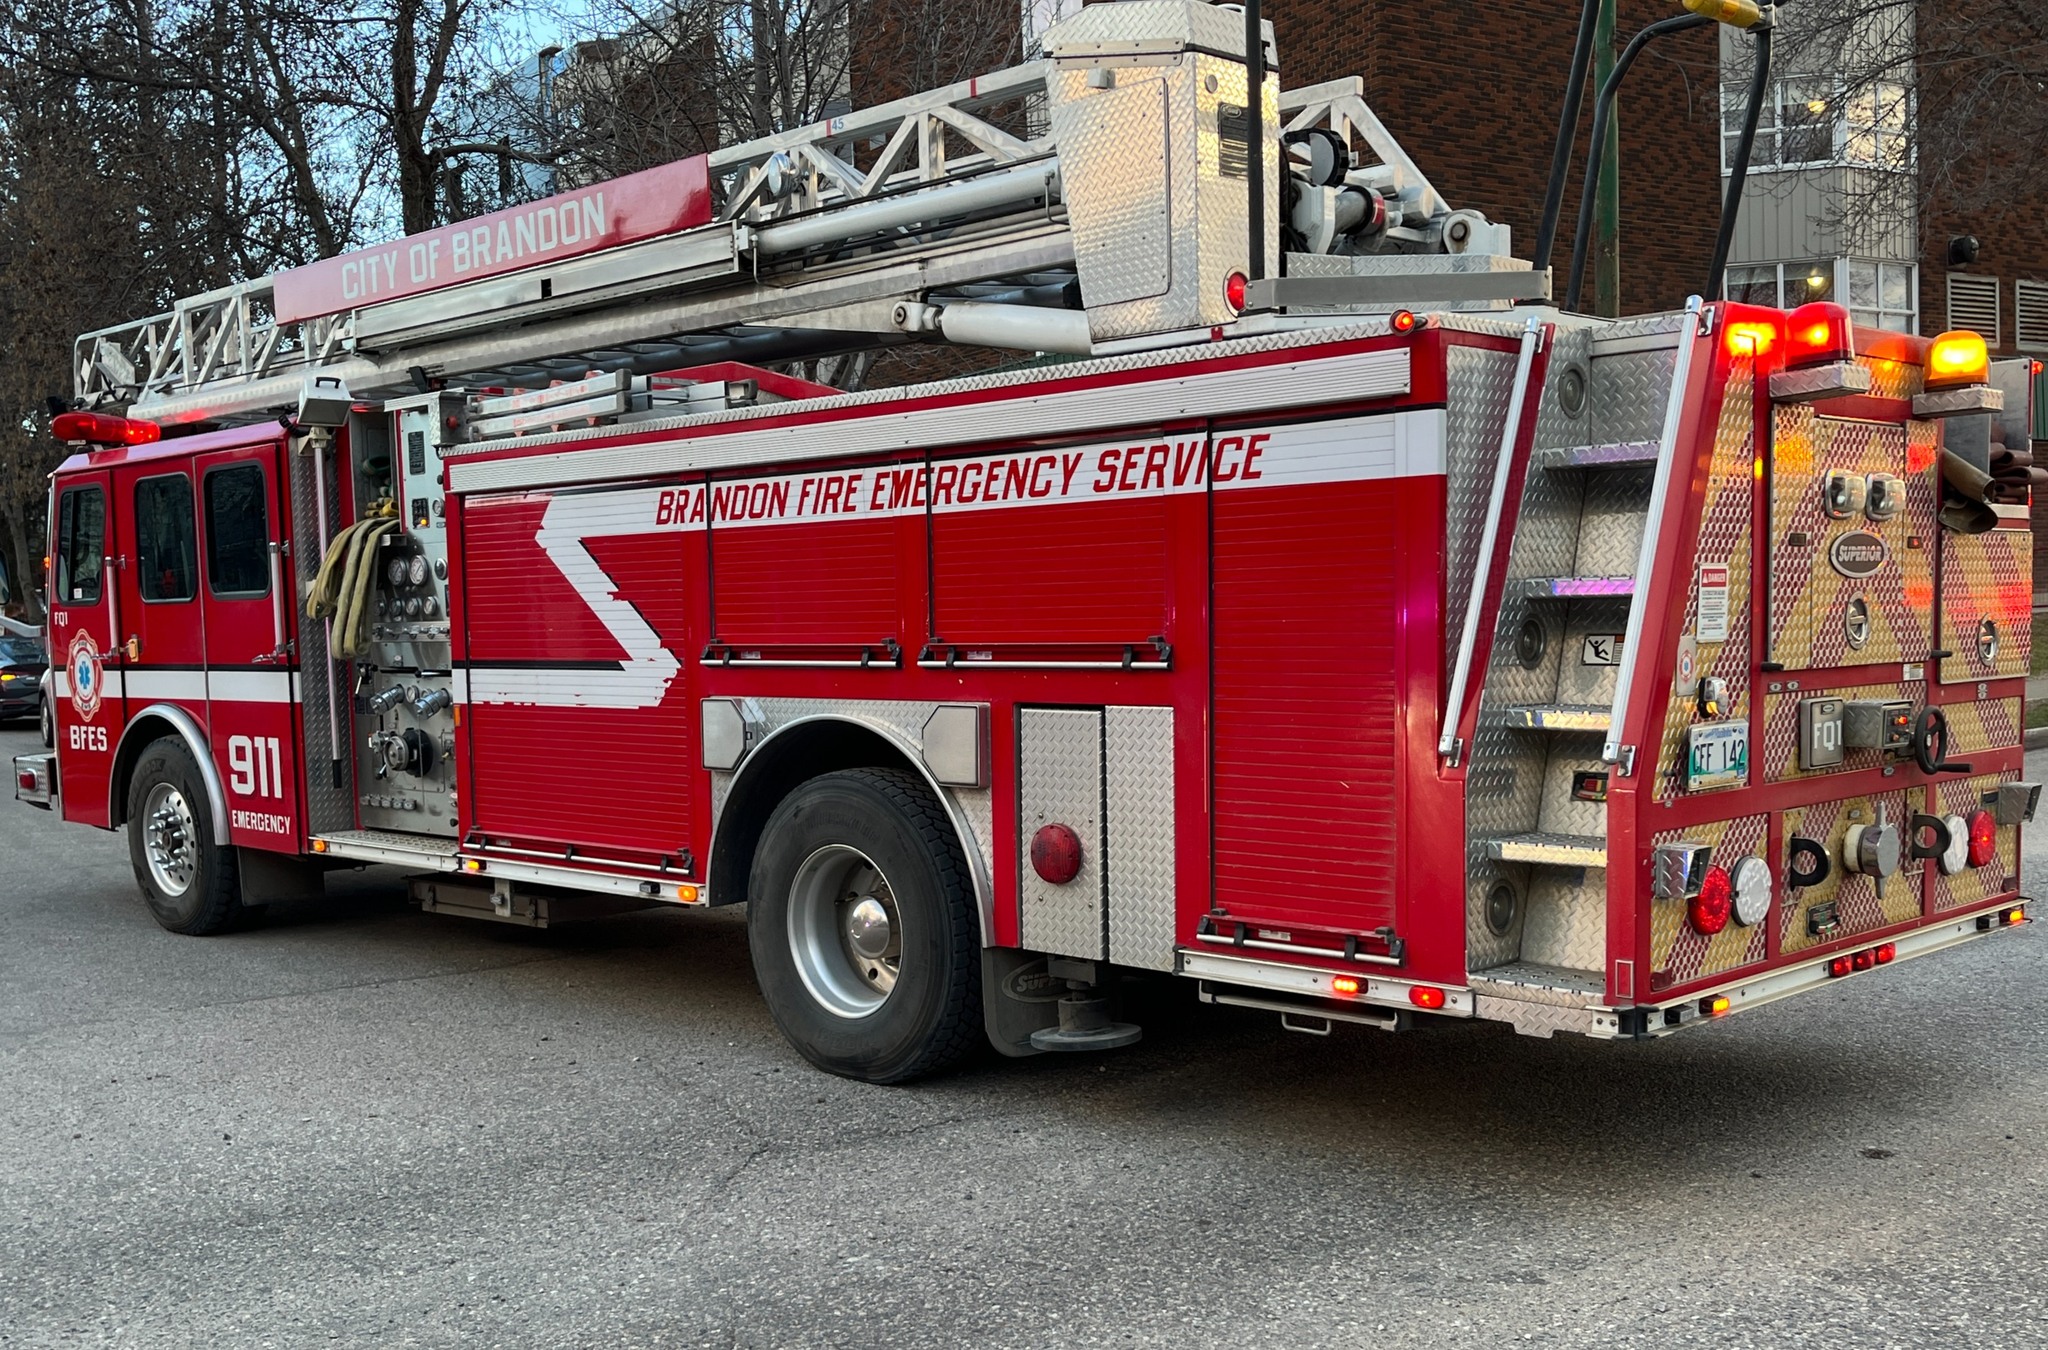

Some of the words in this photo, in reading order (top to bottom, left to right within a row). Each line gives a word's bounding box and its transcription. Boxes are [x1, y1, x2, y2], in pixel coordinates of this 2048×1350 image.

[832, 117, 844, 130] 45
[341, 250, 398, 300] CITY
[409, 238, 441, 284] OF
[452, 192, 606, 273] BRANDON
[655, 480, 791, 525] BRANDON
[796, 474, 863, 516] FIRE
[869, 452, 1084, 511] EMERGENCY
[1092, 433, 1271, 493] SERVICE
[1838, 545, 1882, 562] SUPERIOR
[54, 611, 68, 627] FQ1
[70, 725, 108, 751] BFES
[1814, 719, 1842, 751] FQ1
[228, 735, 282, 798] 911
[1693, 742, 1714, 773] CFF
[1723, 739, 1745, 769] 142
[231, 809, 291, 835] EMERGENCY
